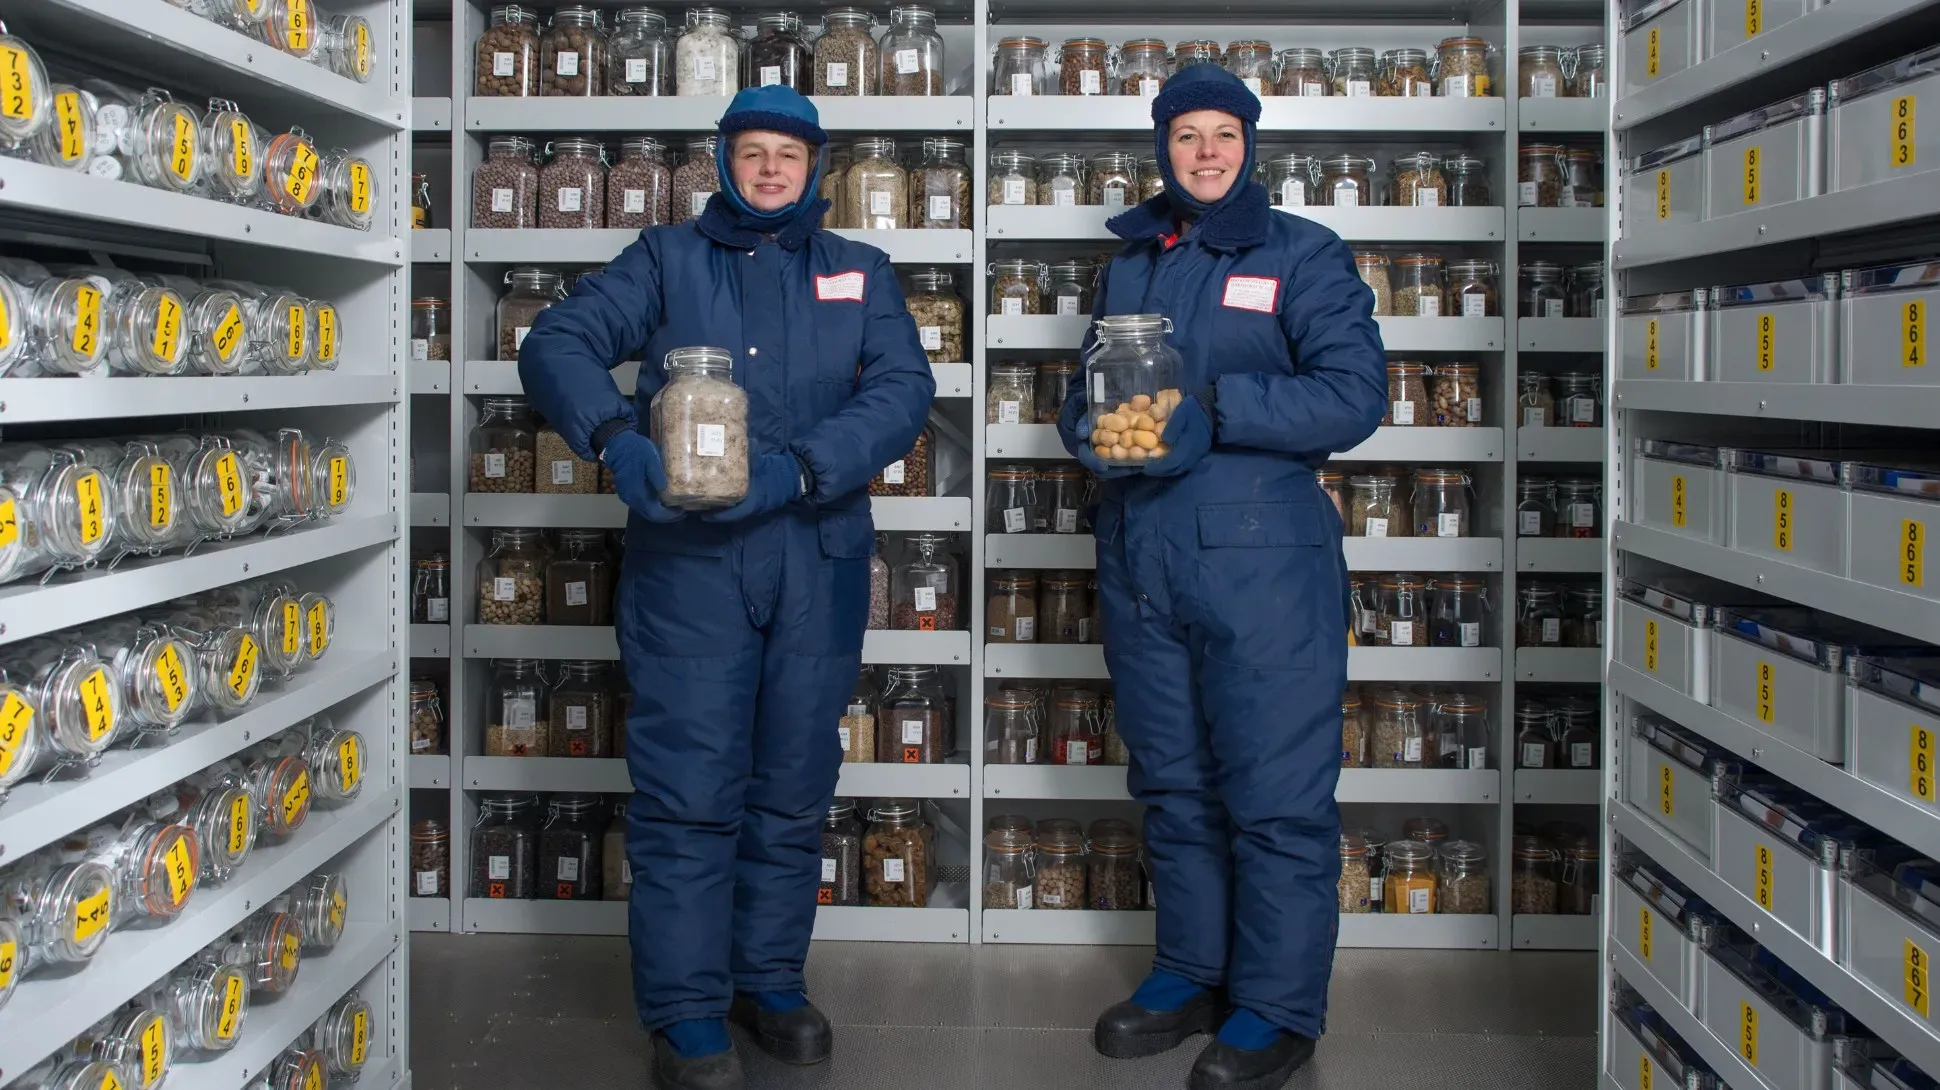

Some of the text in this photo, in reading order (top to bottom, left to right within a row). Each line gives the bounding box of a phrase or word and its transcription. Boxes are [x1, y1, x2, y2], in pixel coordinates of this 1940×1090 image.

[8, 49, 23, 115] 732
[64, 96, 78, 157] 741
[178, 119, 189, 175] 750
[238, 122, 248, 174] 759
[1898, 98, 1908, 164] 863
[291, 149, 312, 197] 768
[355, 165, 366, 210] 777
[1747, 150, 1756, 203] 854
[80, 290, 95, 352] 742
[161, 302, 175, 357] 751
[292, 308, 301, 357] 769
[322, 310, 330, 358] 778
[1762, 315, 1770, 370] 855
[1908, 302, 1919, 365] 864
[85, 477, 97, 538] 743
[156, 467, 165, 524] 752
[222, 457, 236, 510] 761
[334, 459, 343, 503] 779
[1675, 477, 1683, 526] 847
[1779, 491, 1788, 549] 856
[1906, 522, 1917, 584] 865
[287, 604, 295, 649] 771
[312, 604, 322, 650] 780
[161, 652, 183, 703] 753
[233, 640, 254, 693] 762
[1761, 664, 1769, 721] 857
[89, 675, 107, 733] 744
[344, 740, 354, 786] 781
[1917, 729, 1928, 797] 866
[285, 782, 308, 816] 772
[1663, 767, 1671, 816] 849
[234, 797, 244, 851] 763
[172, 843, 188, 895] 754
[1760, 847, 1768, 906] 858
[77, 900, 110, 930] 745
[1911, 946, 1921, 1007] 867
[223, 979, 238, 1037] 764
[1745, 1005, 1754, 1062] 859
[149, 1025, 159, 1080] 755
[355, 1013, 364, 1062] 783
